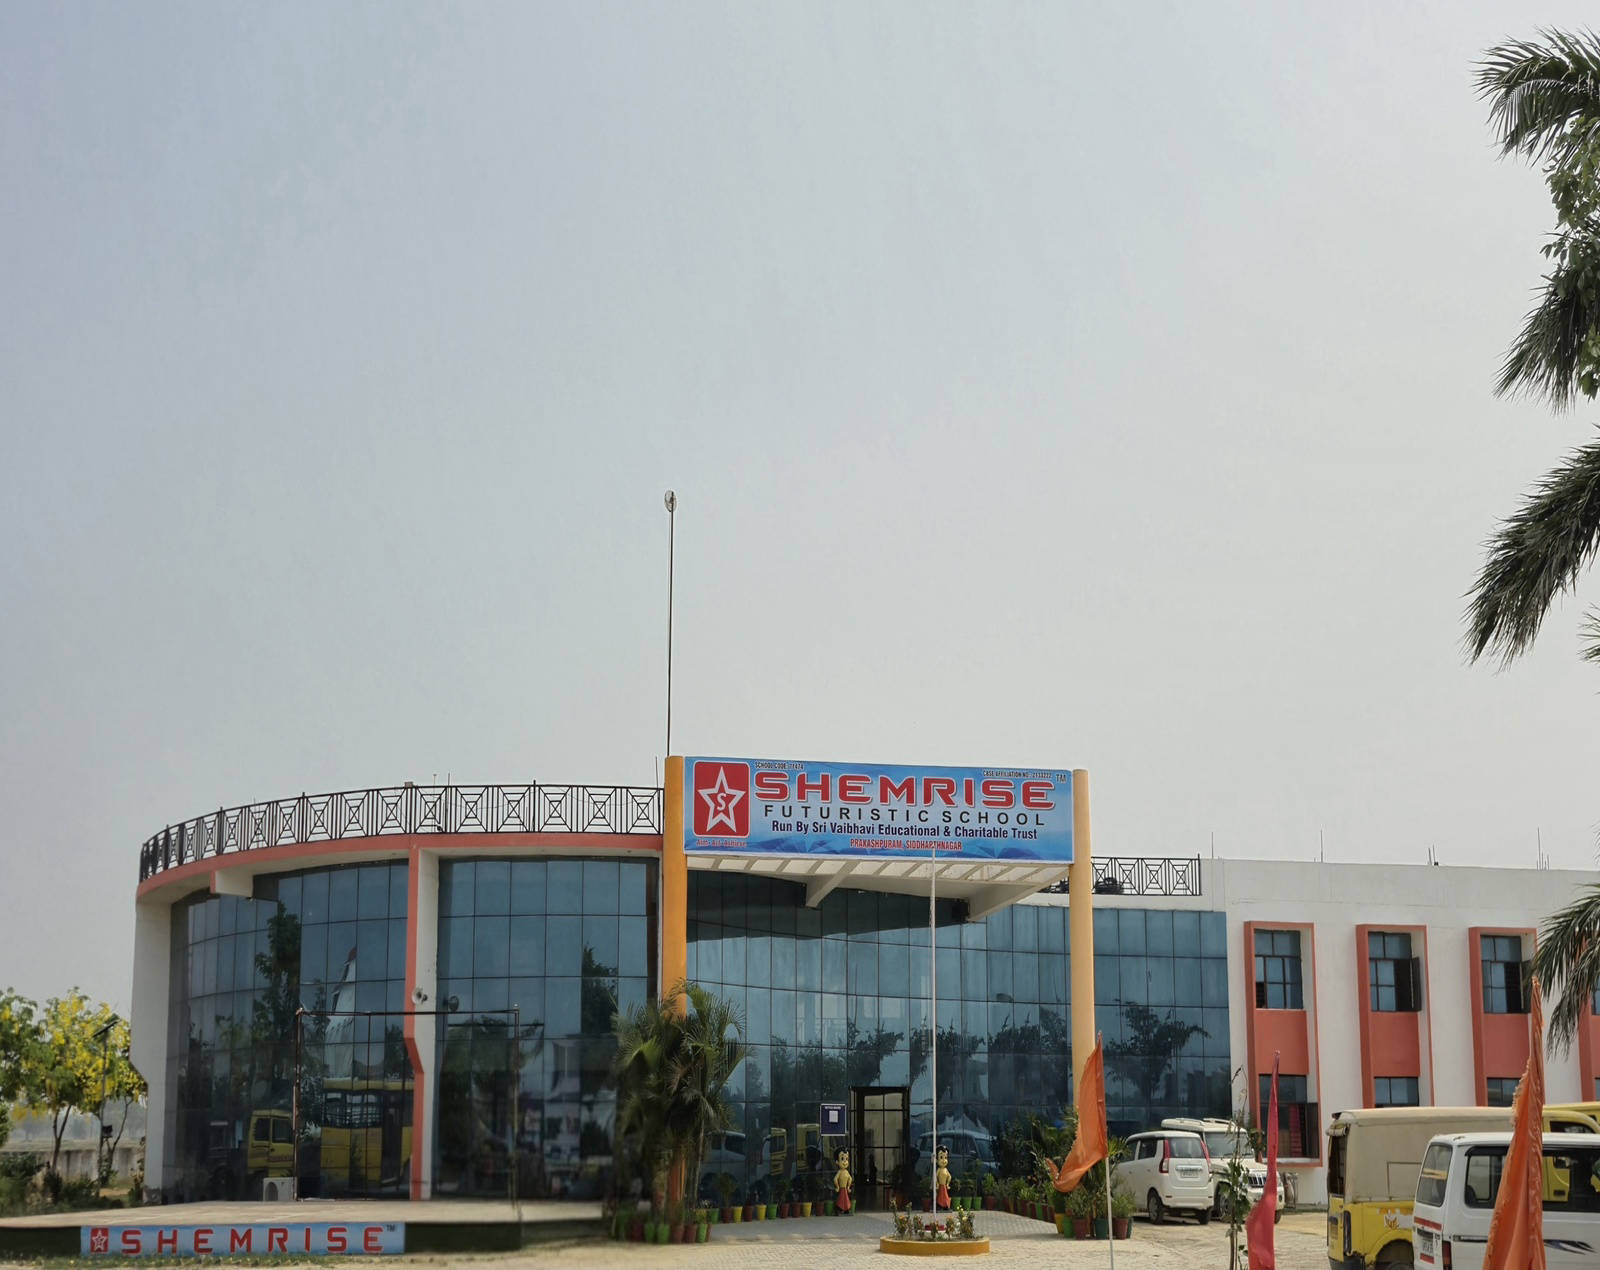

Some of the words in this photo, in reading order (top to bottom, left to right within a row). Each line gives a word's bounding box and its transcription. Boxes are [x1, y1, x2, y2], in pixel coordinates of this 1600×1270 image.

[754, 771, 1056, 810] SHEMRISE
[764, 804, 929, 823] FUTURISTIC
[942, 810, 1045, 826] SCHOOL
[772, 820, 793, 832] Run
[796, 821, 809, 835] By
[813, 822, 827, 833] Sri
[830, 823, 875, 835] Vaibhavi
[878, 824, 940, 837] Educational
[943, 827, 951, 837] &
[954, 826, 1009, 839] Charitable
[1011, 828, 1038, 840] Trust
[121, 1226, 384, 1255] SHEMRISE
